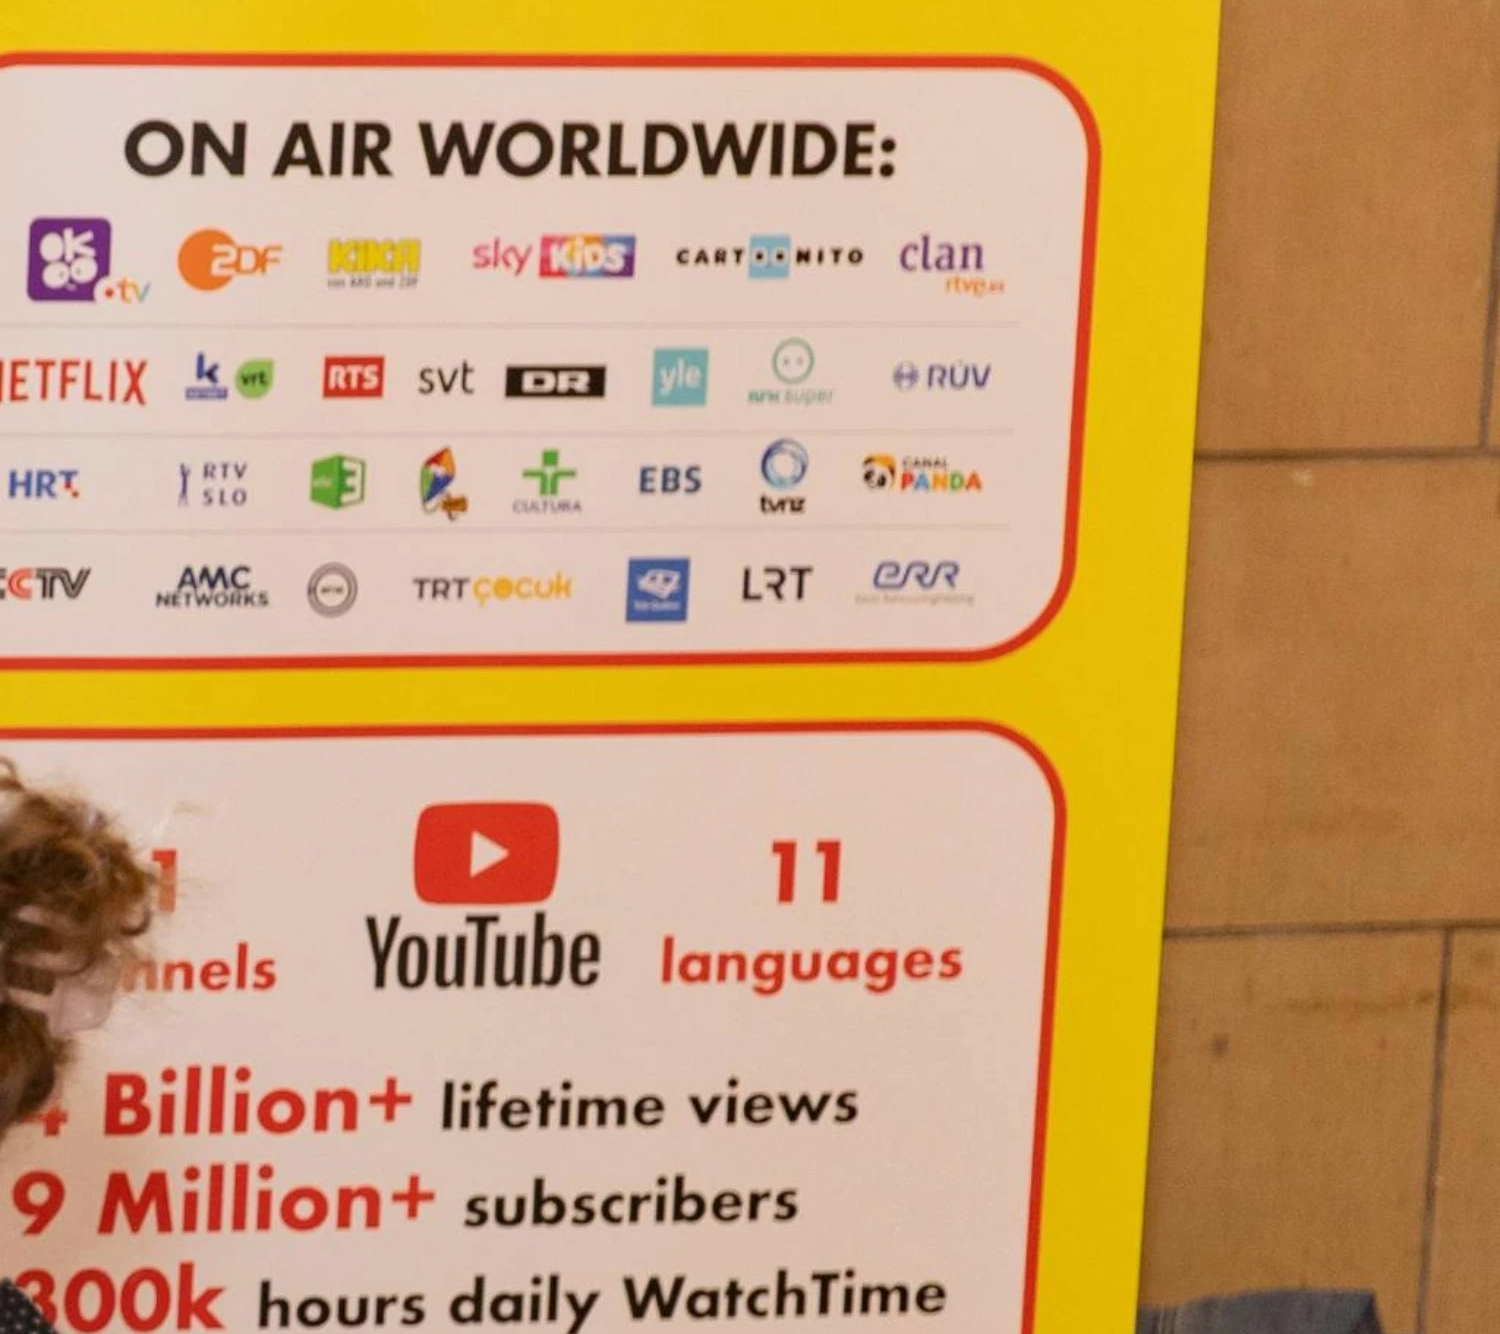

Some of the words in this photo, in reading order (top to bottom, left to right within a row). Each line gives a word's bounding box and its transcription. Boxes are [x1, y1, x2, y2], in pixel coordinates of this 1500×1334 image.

[124, 120, 247, 178] ON
[272, 121, 394, 178] AIR
[418, 121, 897, 178] WORLDWIDE:
[210, 242, 284, 277] ZDF
[472, 237, 532, 276] sky
[900, 234, 984, 272] clan
[328, 364, 379, 390] RTS
[418, 360, 475, 395] svt
[521, 370, 590, 394] DR
[659, 357, 700, 396] yle
[202, 462, 249, 480] RTV
[639, 466, 702, 495] EBS
[901, 471, 983, 492] PANDA
[202, 488, 247, 507] SLO
[178, 565, 252, 589] AMC
[413, 577, 469, 600] TRT
[742, 567, 813, 602] LRT
[155, 591, 269, 609] NETWORKS
[771, 839, 841, 905] 11
[118, 941, 277, 993] nnels
[662, 936, 965, 996] languages
[366, 910, 602, 993] YouTube
[441, 1077, 665, 1132] lifetime
[688, 1083, 860, 1129] views
[12, 1170, 66, 1236] 9
[464, 1174, 798, 1230] subscribers
[15, 1261, 225, 1334] 300k
[258, 1279, 425, 1332] hours
[623, 1266, 948, 1322] WatchTime
